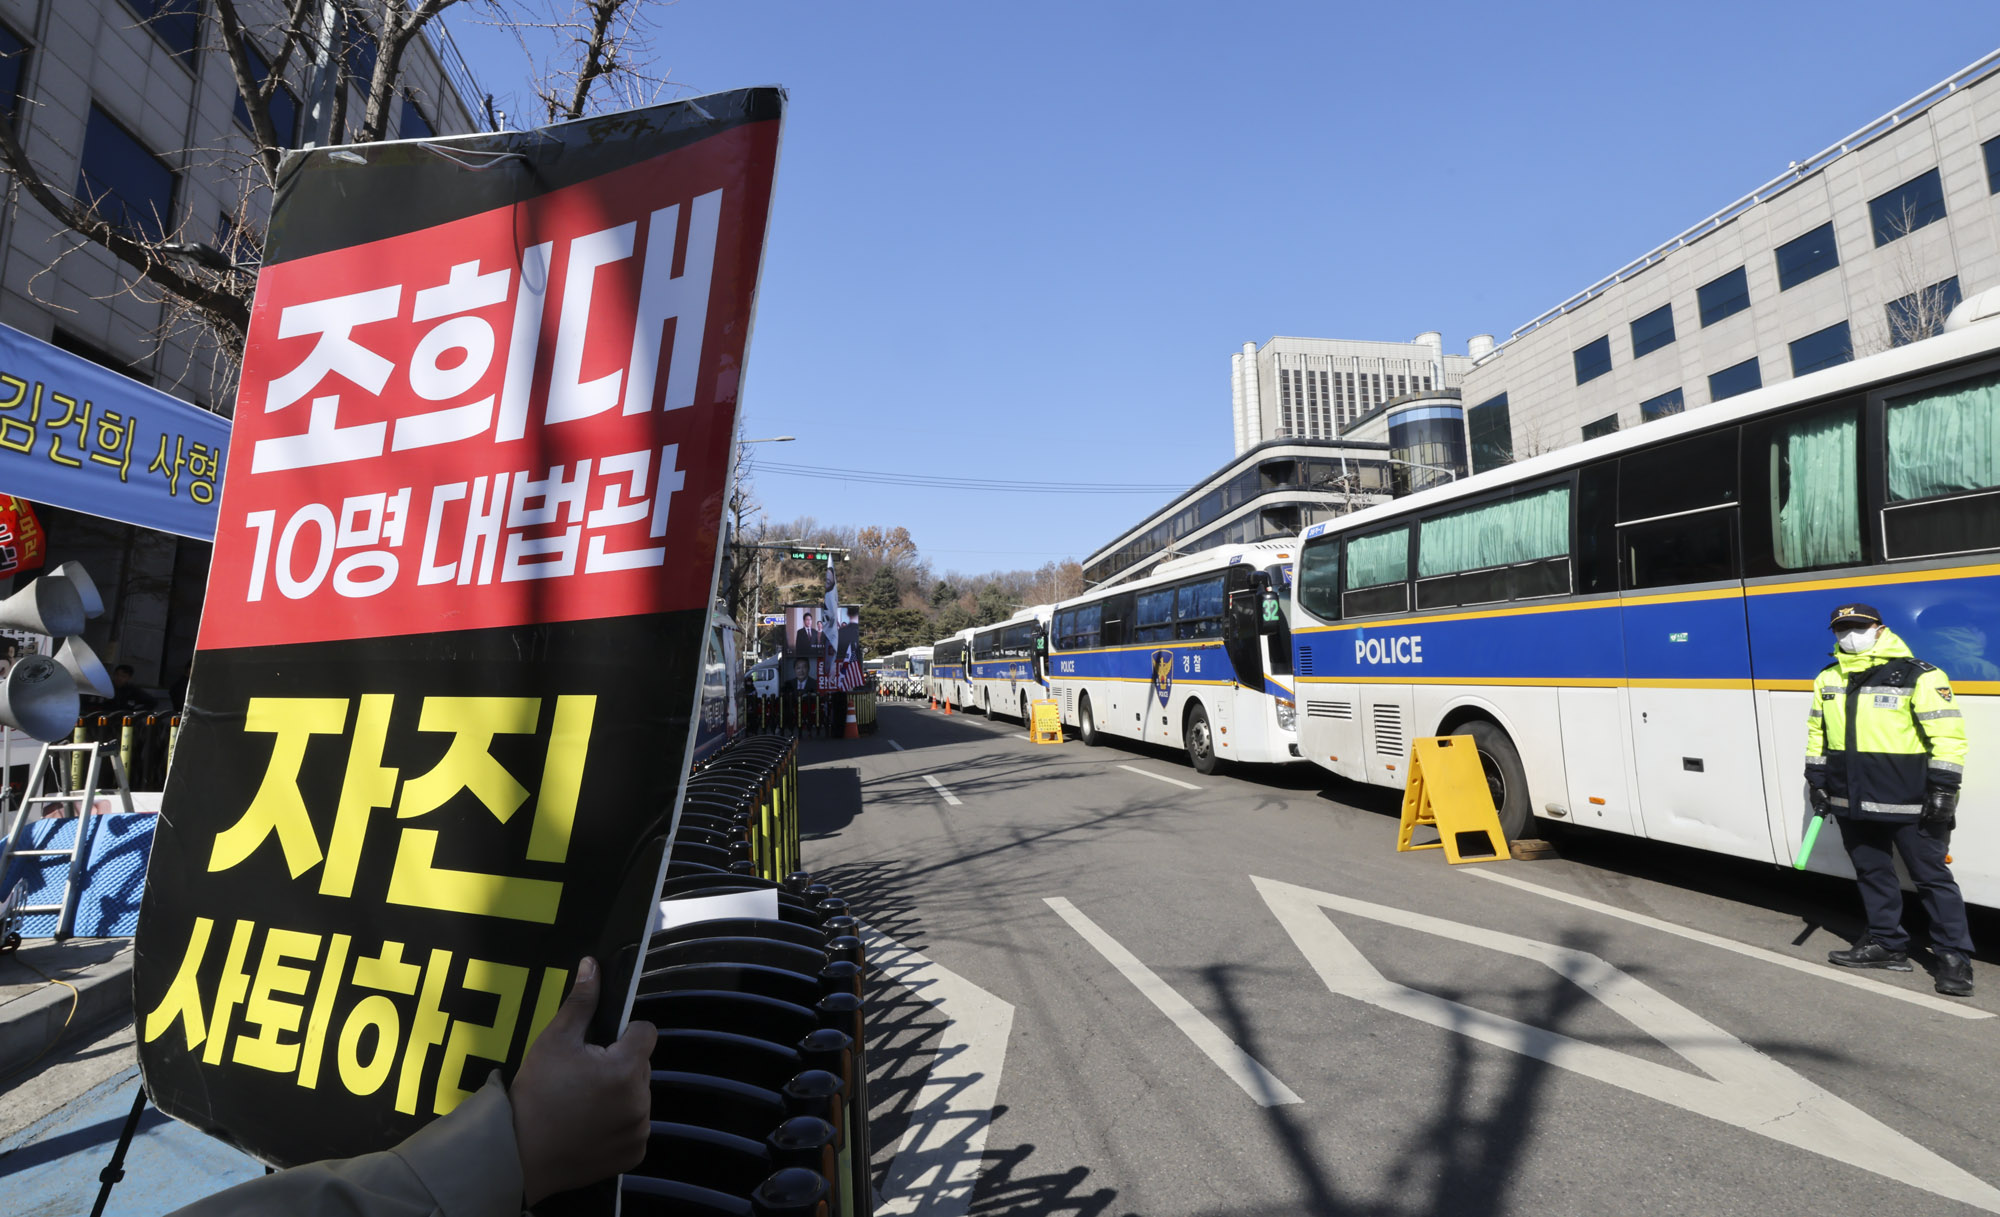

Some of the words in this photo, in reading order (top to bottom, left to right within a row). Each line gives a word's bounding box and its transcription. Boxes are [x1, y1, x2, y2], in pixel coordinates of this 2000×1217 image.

[251, 188, 723, 474] 조희대
[0, 371, 136, 483] 김건희
[149, 433, 220, 505] 사형
[246, 487, 411, 602] 10명
[417, 443, 686, 585] 대법관
[1060, 659, 1075, 673] POLICE
[1262, 599, 1279, 621] 32
[1355, 636, 1423, 665] POLICE
[207, 693, 597, 924] 자진
